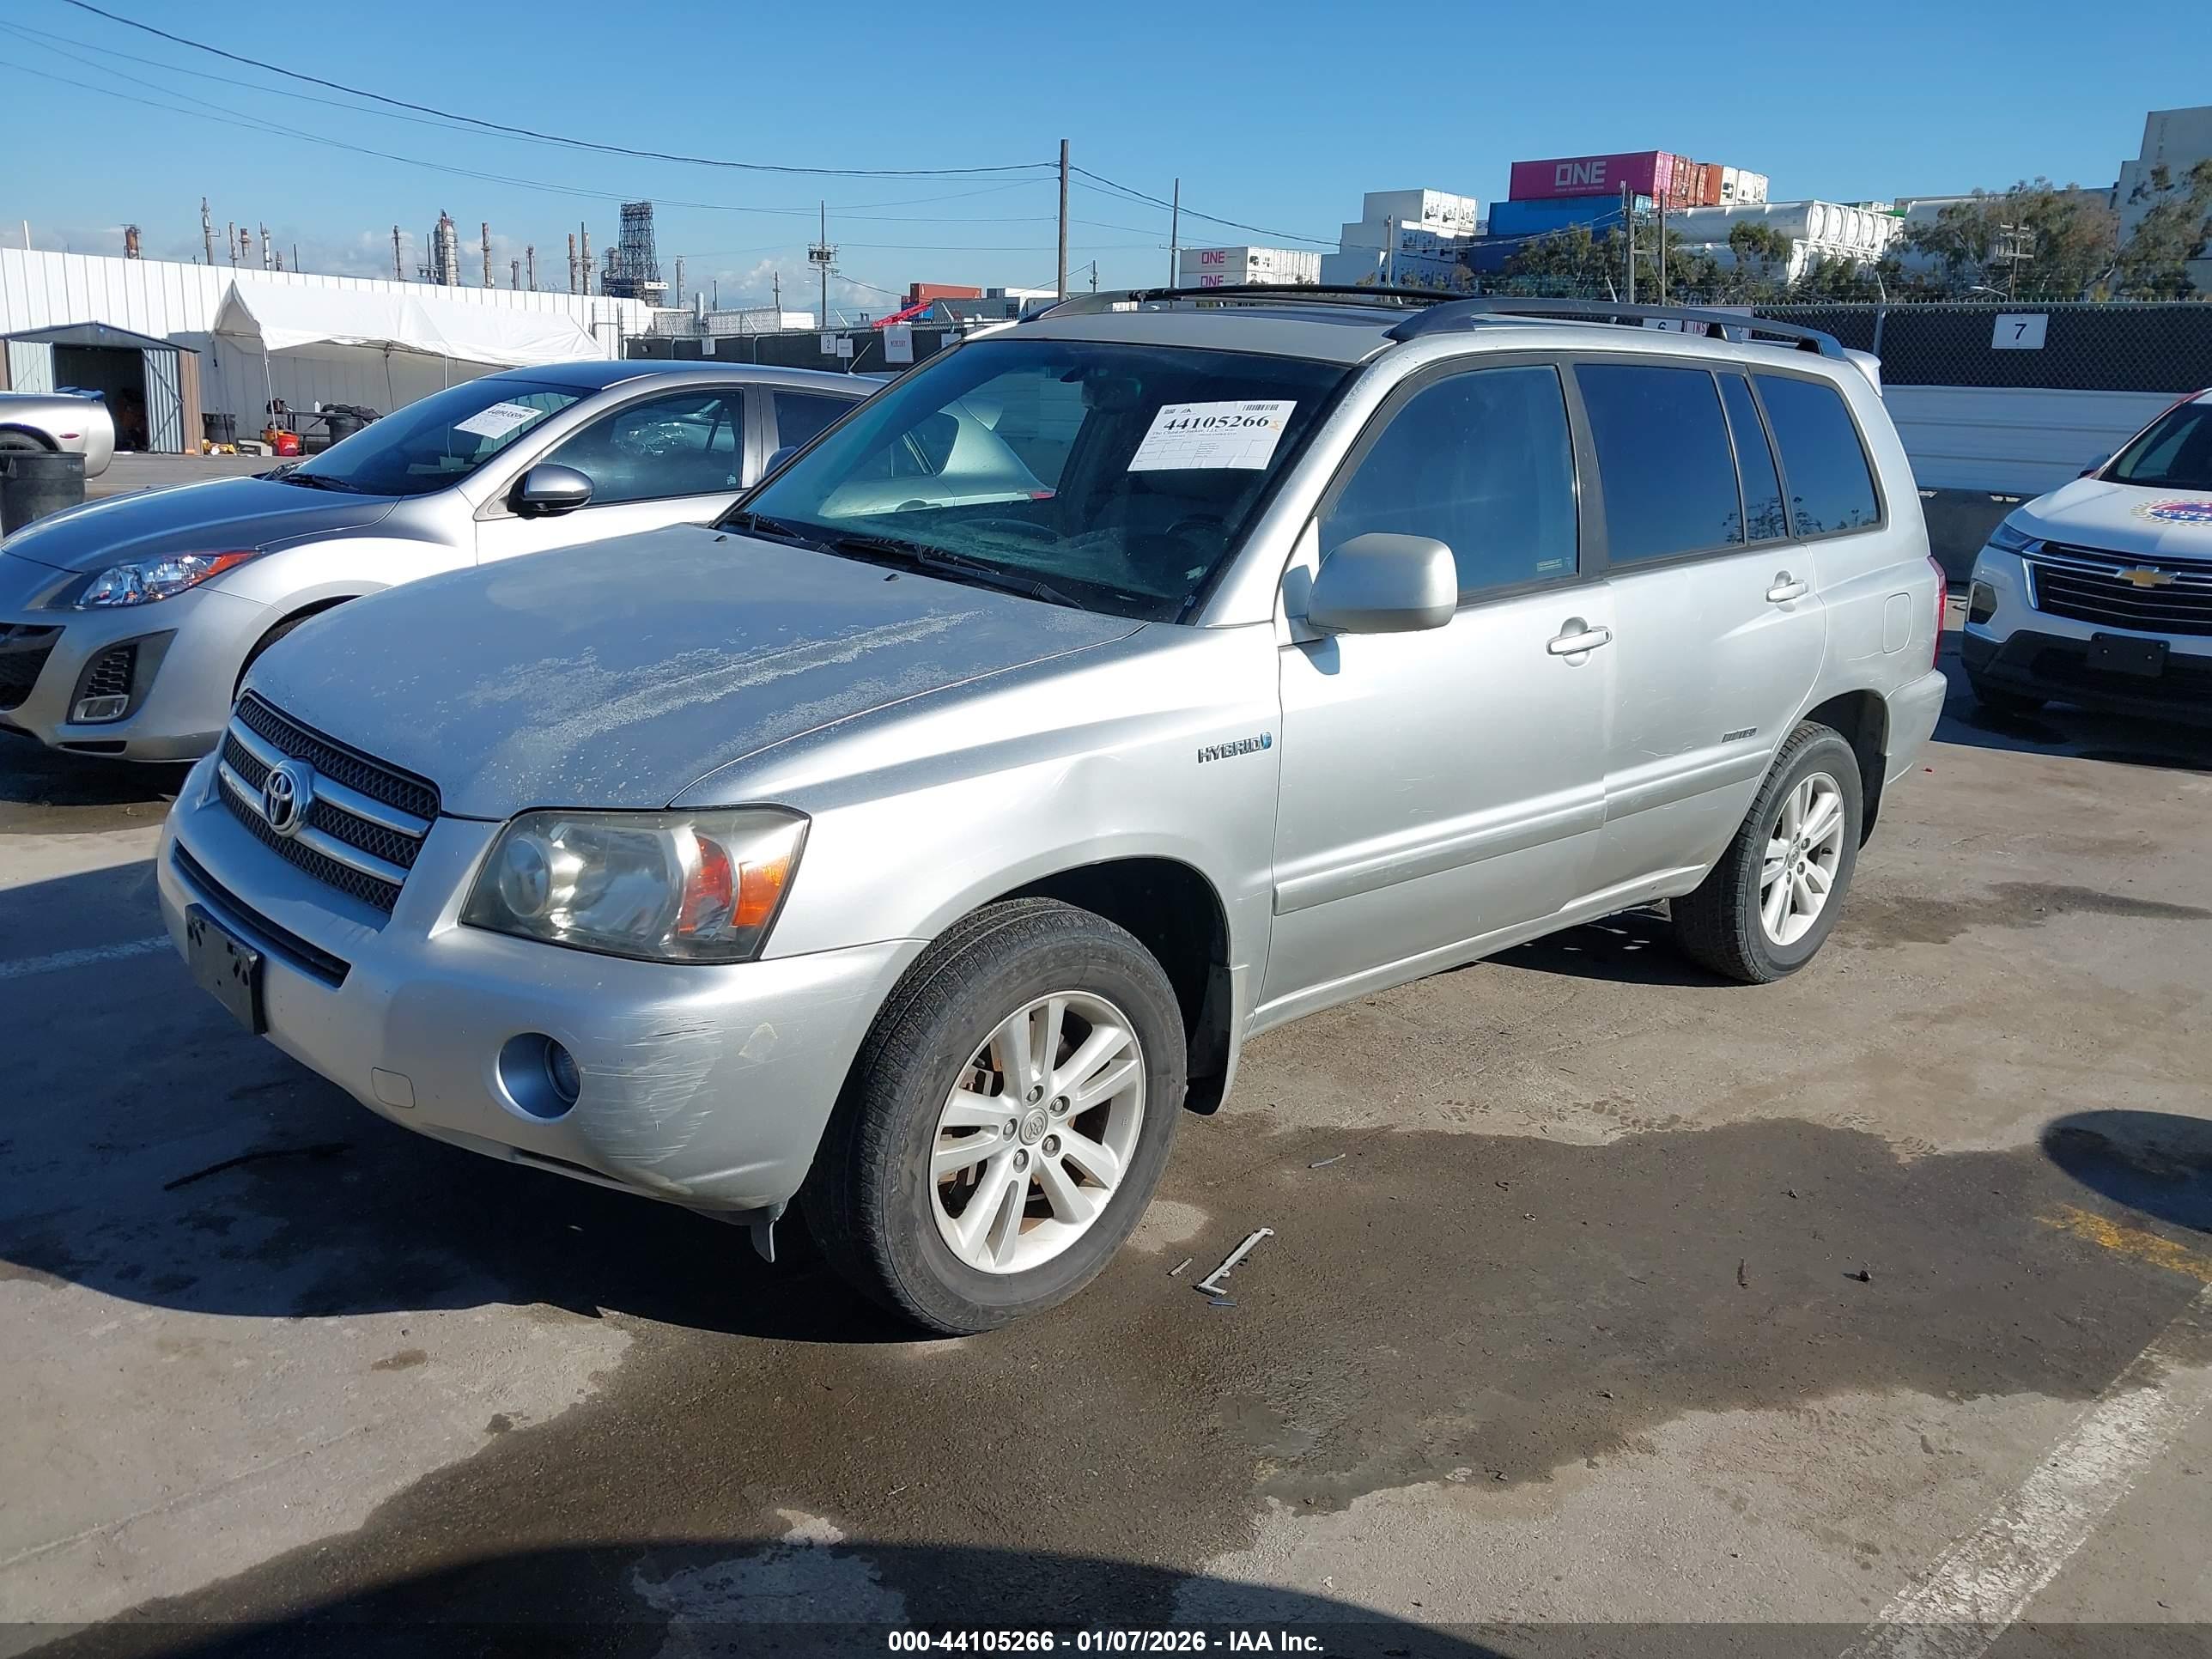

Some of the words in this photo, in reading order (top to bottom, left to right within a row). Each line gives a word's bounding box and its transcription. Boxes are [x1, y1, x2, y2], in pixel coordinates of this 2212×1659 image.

[1555, 161, 1607, 186] ONE
[1201, 251, 1225, 264] ONE
[2014, 323, 2027, 340] 7
[1163, 414, 1272, 431] 44105266
[1197, 736, 1261, 763] HYBRID
